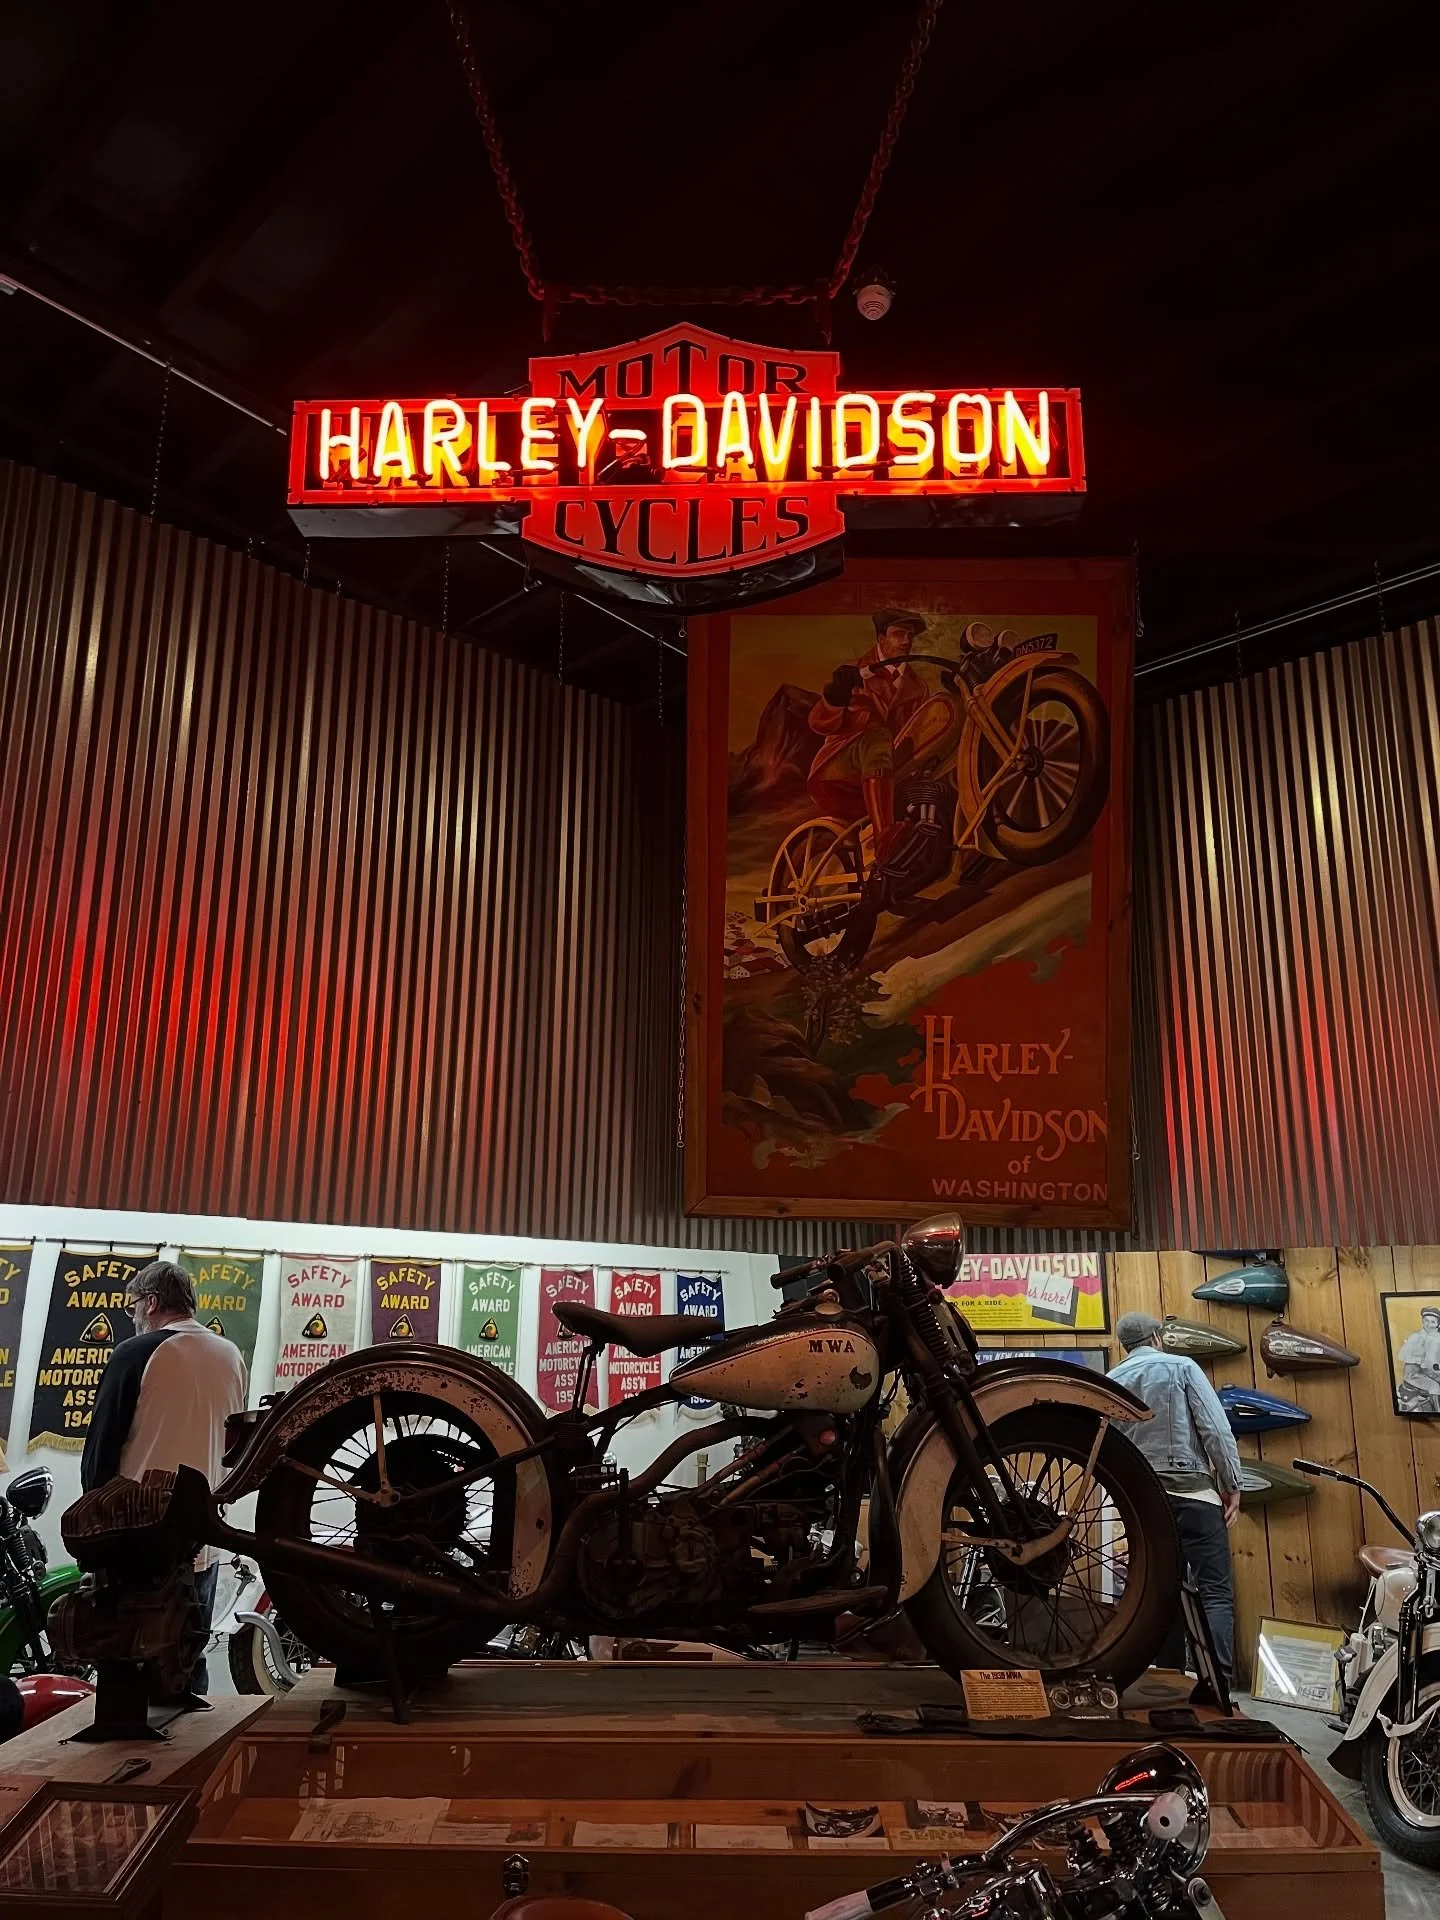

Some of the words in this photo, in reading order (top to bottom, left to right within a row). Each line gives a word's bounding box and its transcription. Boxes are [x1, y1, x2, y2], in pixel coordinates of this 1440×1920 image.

[559, 338, 809, 399] MOTOR
[319, 388, 1052, 482] HARLEY-DAVIDSON
[553, 494, 811, 565] CYCLES
[924, 1015, 1074, 1112] HARLEY-
[911, 1083, 1108, 1162] DAVIDSON
[1007, 1155, 1031, 1175] of
[931, 1178, 1108, 1201] WASHINGTON
[63, 1260, 141, 1288] SAFET
[955, 1252, 1100, 1281] EY-DAVIDSON
[287, 1265, 352, 1288] SAFETY
[376, 1267, 436, 1292] SAFETY
[468, 1271, 516, 1295] SAFETY
[291, 1293, 345, 1308] AWARD
[679, 1281, 722, 1302] SAFETY
[196, 1293, 247, 1312] WARD
[380, 1295, 430, 1311] AWARD
[471, 1298, 511, 1313] AWARD
[683, 1304, 718, 1318] AWARD
[282, 1343, 347, 1358] AMERICAN
[808, 1339, 856, 1353] MWA
[50, 1347, 113, 1365] AMERIC
[38, 1369, 103, 1386] MOTORC
[609, 1361, 660, 1375] MOTORCYCLE
[620, 1376, 647, 1390] ASS'N
[62, 1390, 96, 1407] ASS
[556, 1390, 577, 1404] 195
[63, 1411, 93, 1428] 194
